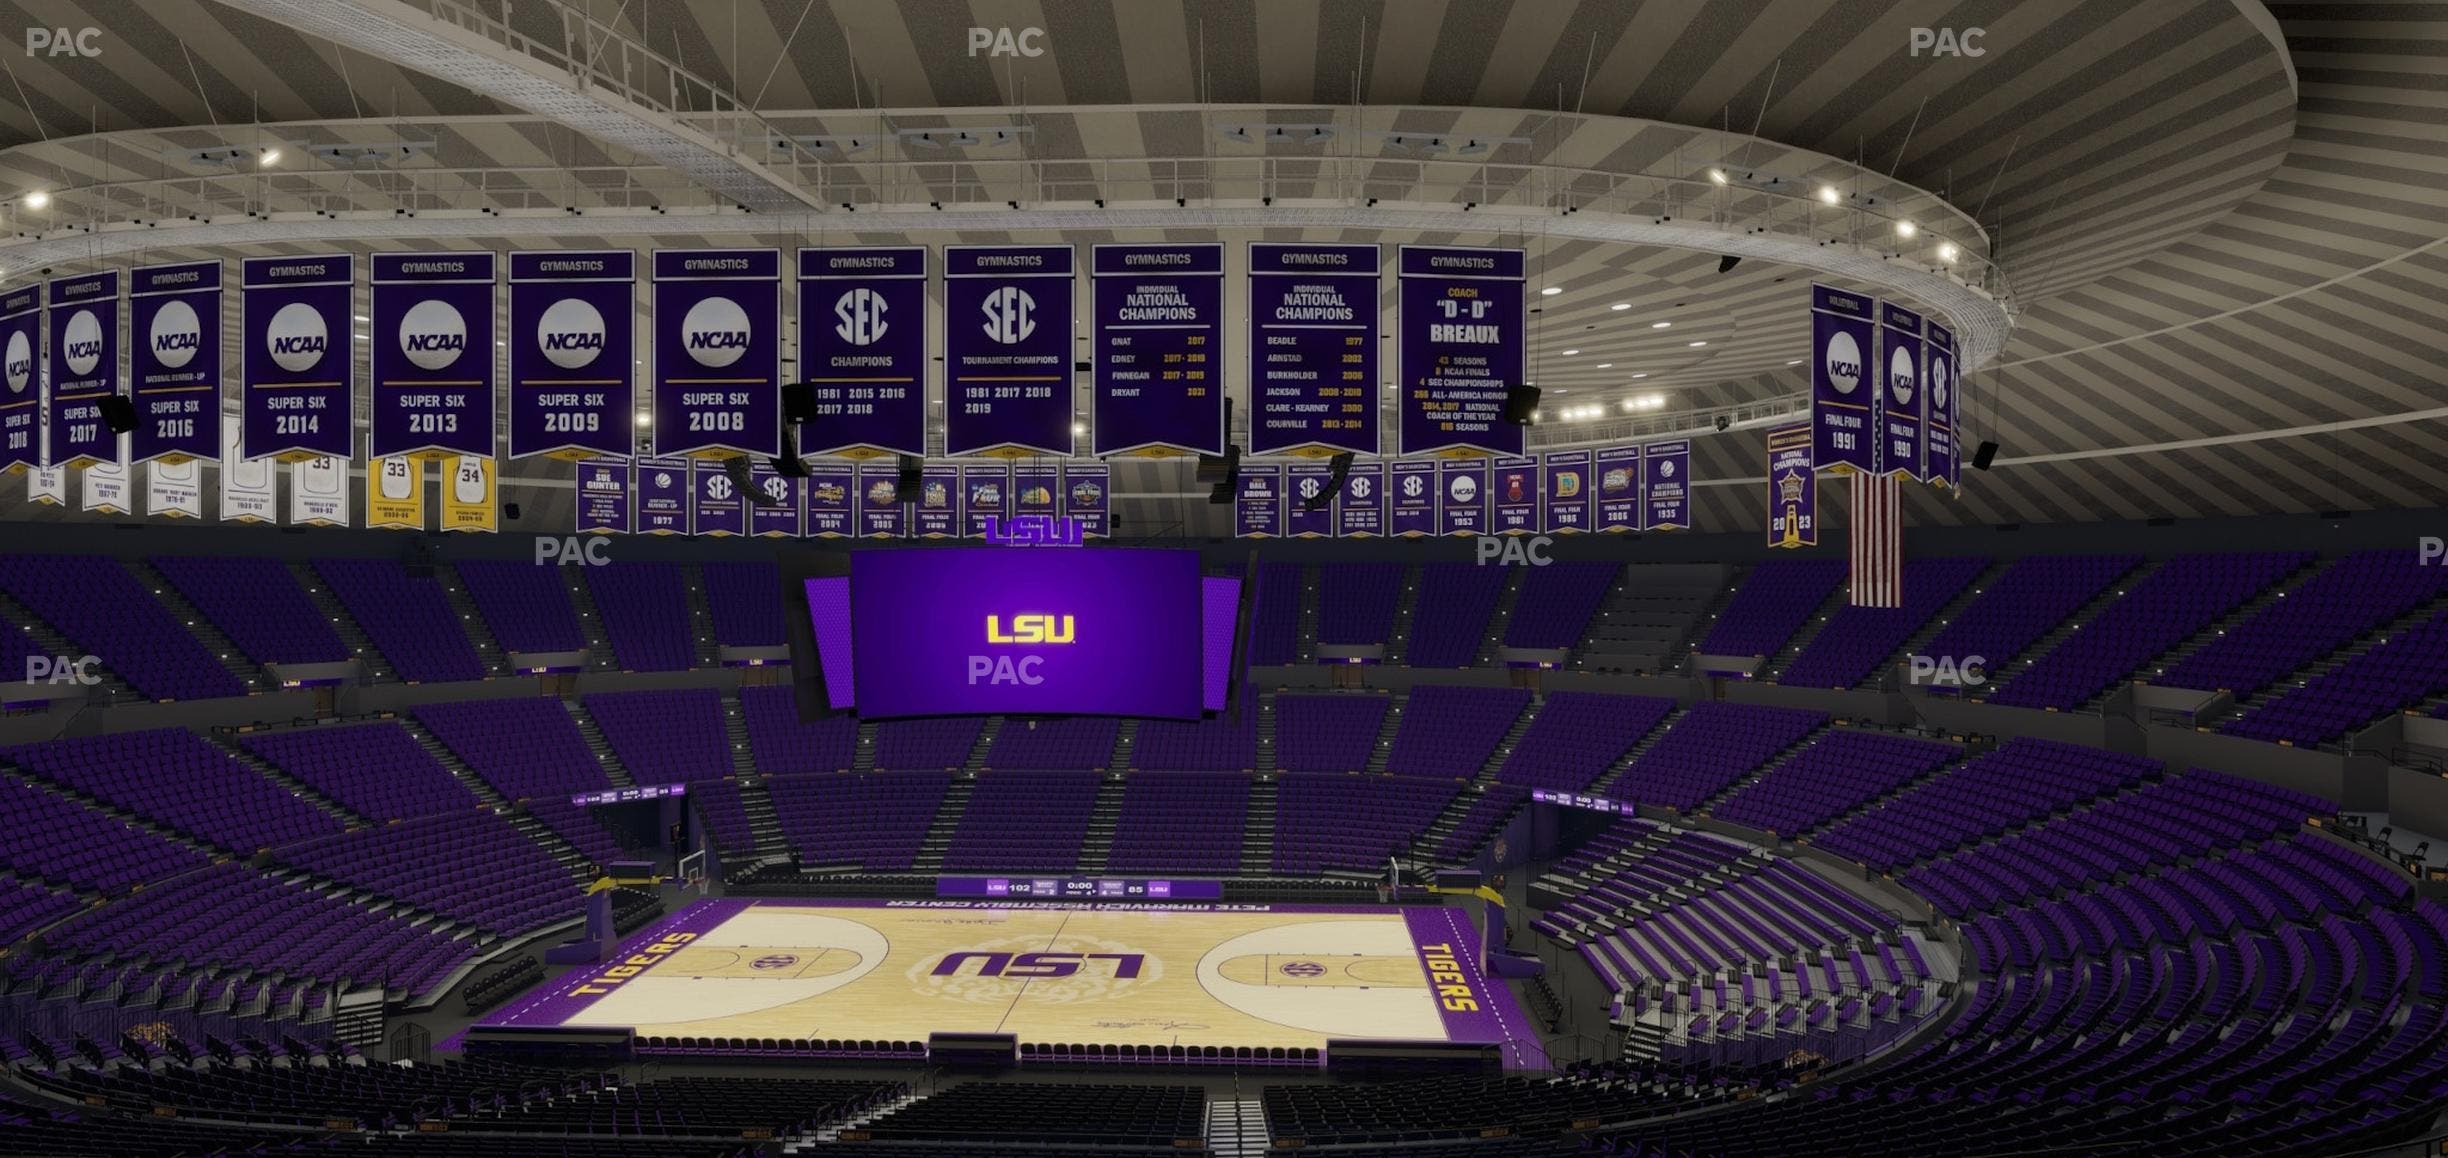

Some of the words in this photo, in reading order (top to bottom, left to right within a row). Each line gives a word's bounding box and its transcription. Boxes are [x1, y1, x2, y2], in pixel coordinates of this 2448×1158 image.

[540, 260, 604, 272] GYMNASTICS
[684, 259, 749, 270] GYMNASTICS
[830, 257, 895, 269] GYMNASTICS
[977, 255, 1042, 267] GYMNASTICS
[1125, 254, 1191, 265] GYMNASTICS
[1281, 253, 1348, 265] GYMNASTICS
[1431, 256, 1495, 269] GYMNASTICS
[269, 265, 326, 277] GYMNASTICS
[401, 262, 465, 273] GYMNASTICS
[1136, 285, 1179, 294] INDIVIDUAL
[1293, 285, 1335, 294] INDIVIDUAL
[1448, 288, 1478, 298] COACH
[1126, 294, 1189, 306] NATIONAL
[1284, 294, 1345, 306] NATIONAL
[834, 287, 889, 346] SEC
[981, 286, 1037, 345] SEC
[1119, 307, 1196, 321] CHAMPIONS
[1276, 307, 1353, 321] CHAMPIONS
[546, 332, 603, 350] NCAA
[690, 331, 749, 349] NCAA
[1430, 324, 1500, 344] BREAUX
[156, 333, 199, 351] NCAA
[274, 336, 325, 354] NCAA
[407, 333, 464, 351] NCAA
[68, 341, 101, 359] NCAA
[831, 356, 893, 367] CHAMPIONS
[962, 356, 1012, 366] TOURNAMENT
[1013, 355, 1059, 365] CHAMPIONS
[1453, 357, 1487, 366] SEASONS
[1831, 361, 1859, 379] NCAA
[538, 394, 579, 406] SUPER
[584, 393, 604, 406] SIX
[683, 393, 724, 405] SUPER
[729, 393, 750, 405] SIX
[817, 388, 840, 399] 1981
[848, 388, 874, 399] 2015
[879, 388, 905, 399] 2016
[965, 387, 989, 398] 1981
[994, 387, 1020, 398] 2017
[1025, 387, 1051, 398] 2018
[151, 401, 181, 414] SUPER
[184, 400, 199, 413] SIX
[267, 397, 303, 410] SUPER
[308, 396, 327, 408] SIX
[400, 395, 440, 407] SUPER
[445, 394, 466, 407] SIX
[64, 408, 87, 420] SUPER
[817, 404, 842, 415] 2017
[847, 404, 873, 415] 2018
[965, 403, 991, 414] 2019
[5, 414, 21, 427] SUPER
[276, 415, 319, 434] 2014
[409, 414, 457, 433] 2013
[545, 413, 599, 432] 2009
[689, 412, 744, 431] 2008
[1825, 413, 1844, 425] FINAL
[1844, 416, 1861, 428] FOUR
[70, 424, 97, 443] 2017
[157, 419, 194, 438] 2016
[1833, 432, 1856, 450] 1991
[1894, 440, 1911, 458] 1990
[388, 462, 406, 477] 33
[1773, 458, 1810, 471] CHAMPIONS
[462, 469, 479, 482] 34
[706, 474, 733, 500] SEC
[1351, 476, 1371, 498] SEC
[1403, 475, 1423, 497] SEC
[1773, 517, 1785, 531] 20
[1799, 515, 1811, 529] 23
[987, 615, 1075, 644] LSU
[1009, 884, 1031, 892] 102
[568, 932, 697, 997] TIGERS
[931, 951, 1145, 979] LSU
[1422, 943, 1479, 1011] TIGERS
